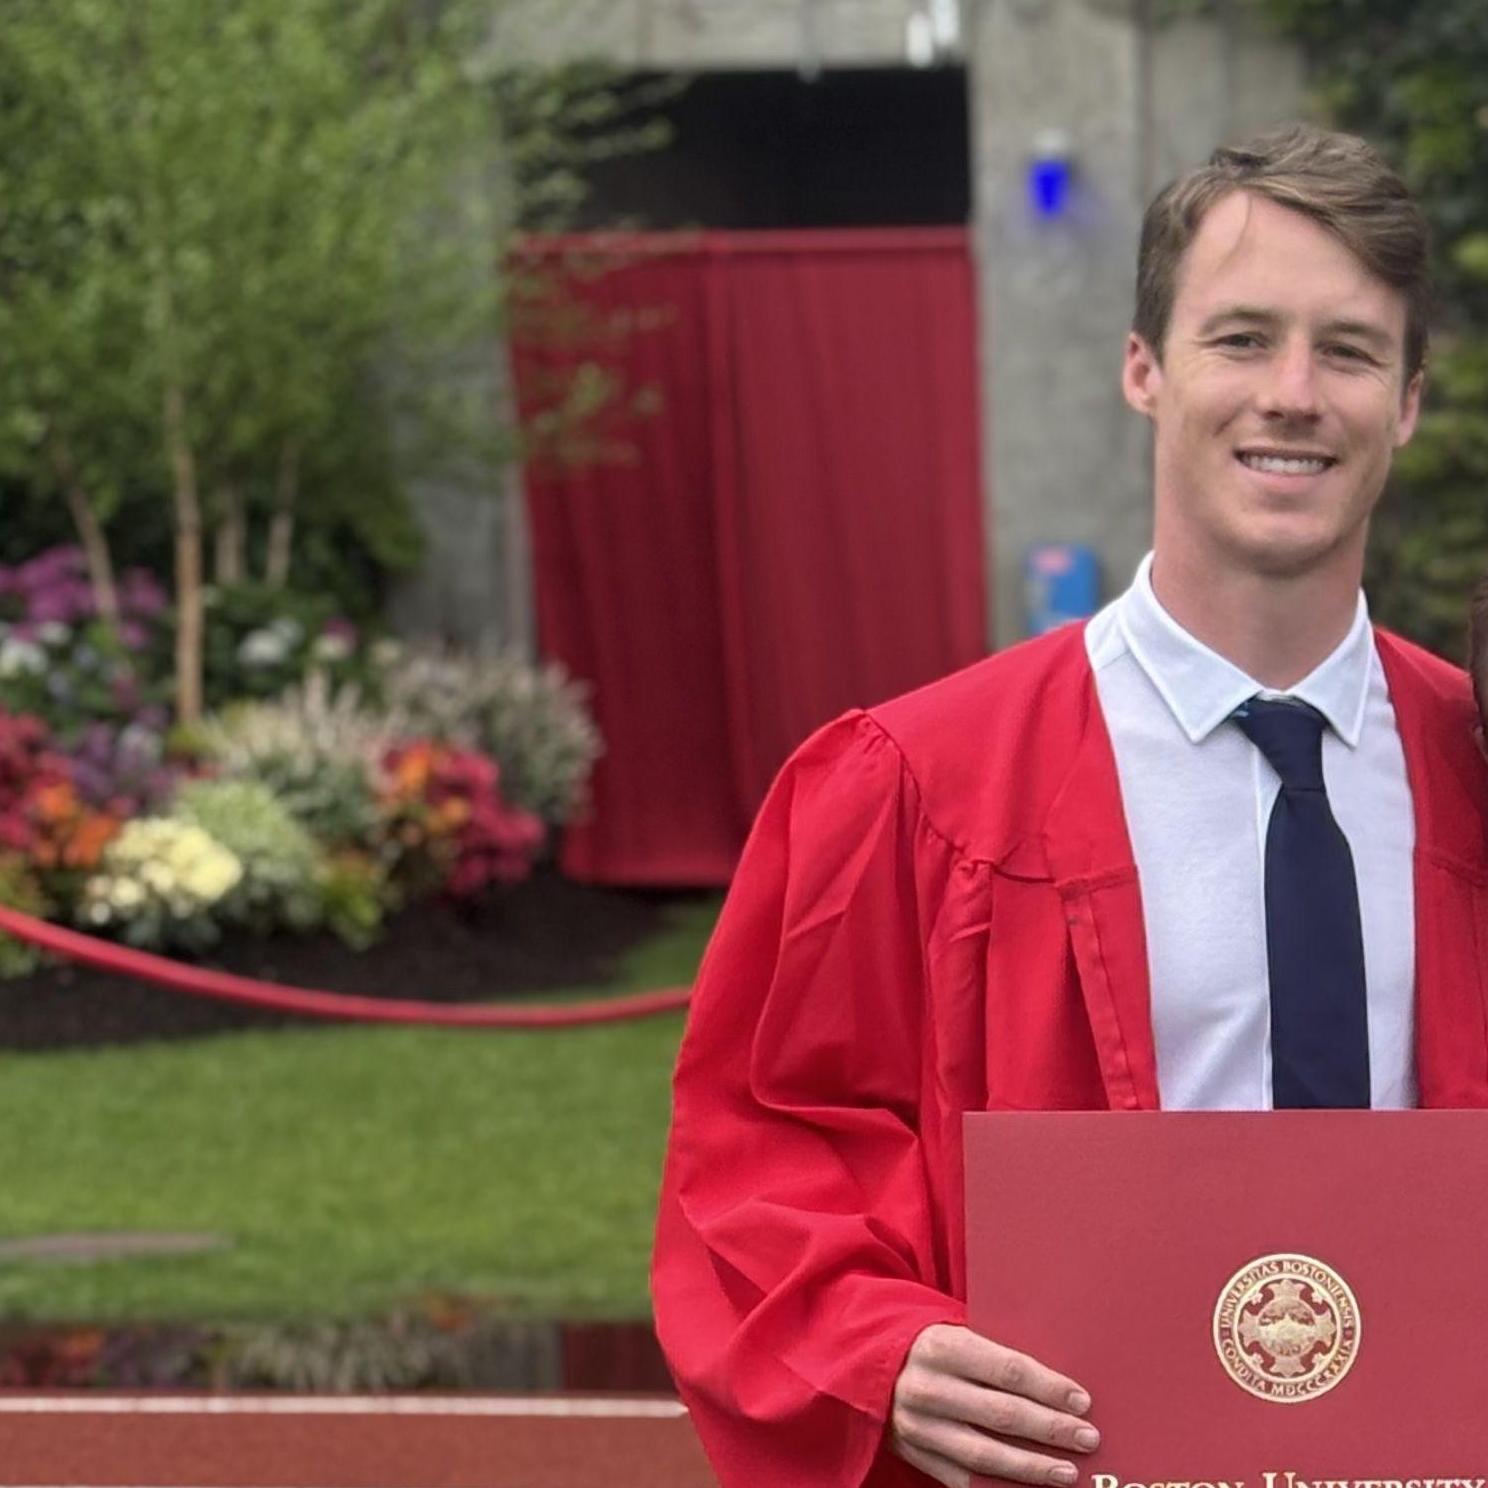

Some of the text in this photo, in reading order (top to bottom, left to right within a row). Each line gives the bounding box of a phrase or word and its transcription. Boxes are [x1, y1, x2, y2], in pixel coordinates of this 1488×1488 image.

[1220, 1261, 1355, 1330] UNIVERSITAS BOSTONIENSIS
[1222, 1339, 1267, 1391] CONDITA
